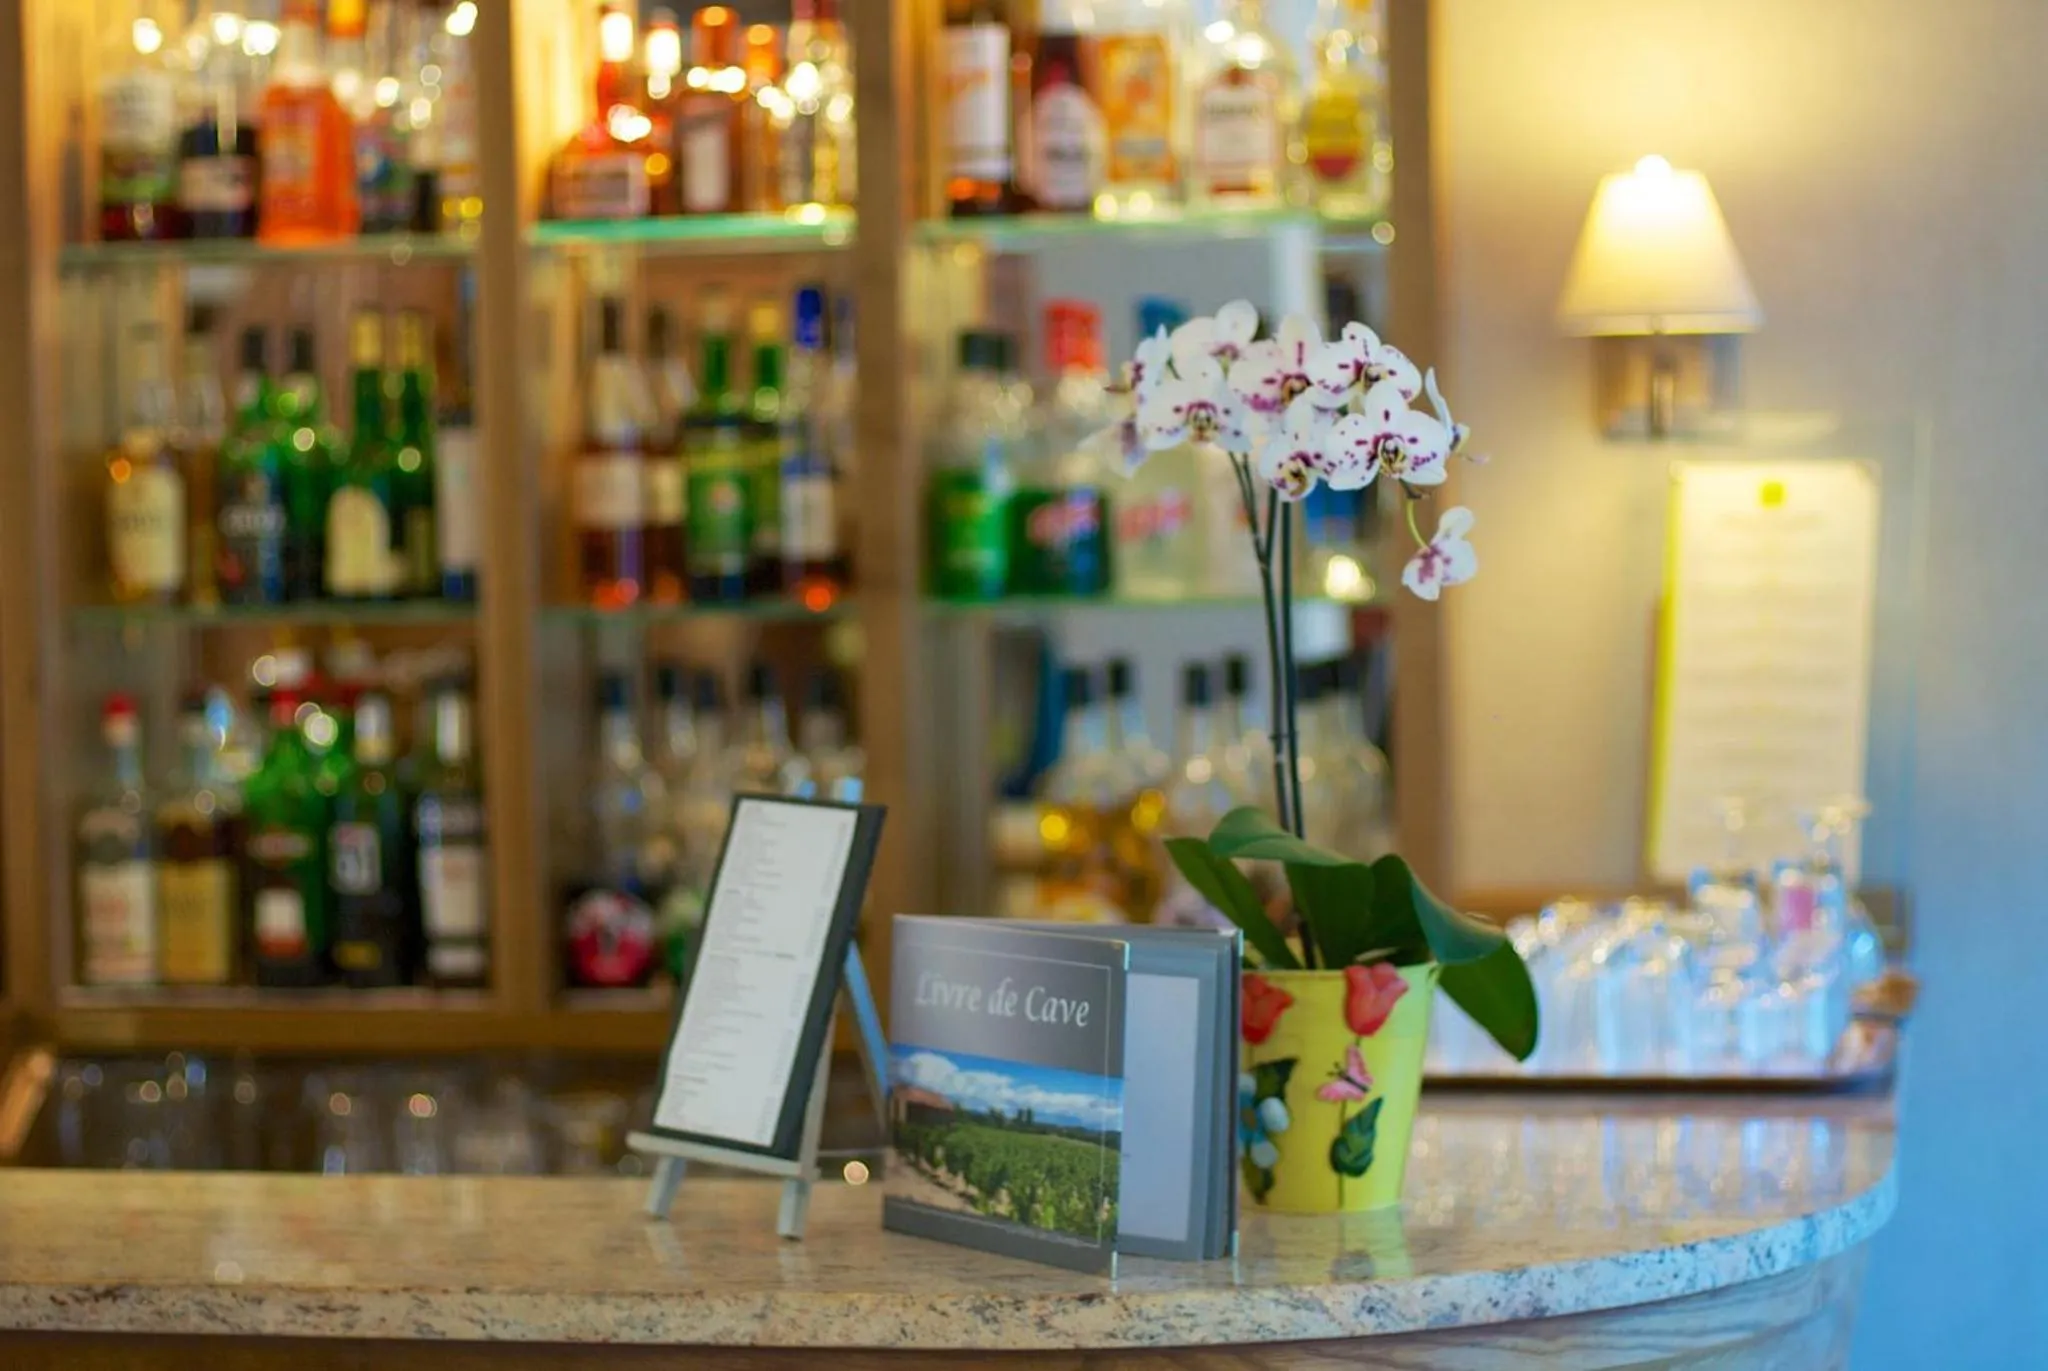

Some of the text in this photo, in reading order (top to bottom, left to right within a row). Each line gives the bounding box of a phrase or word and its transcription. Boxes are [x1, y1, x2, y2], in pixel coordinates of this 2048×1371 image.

[914, 969, 1090, 1027] Livre de Cave
